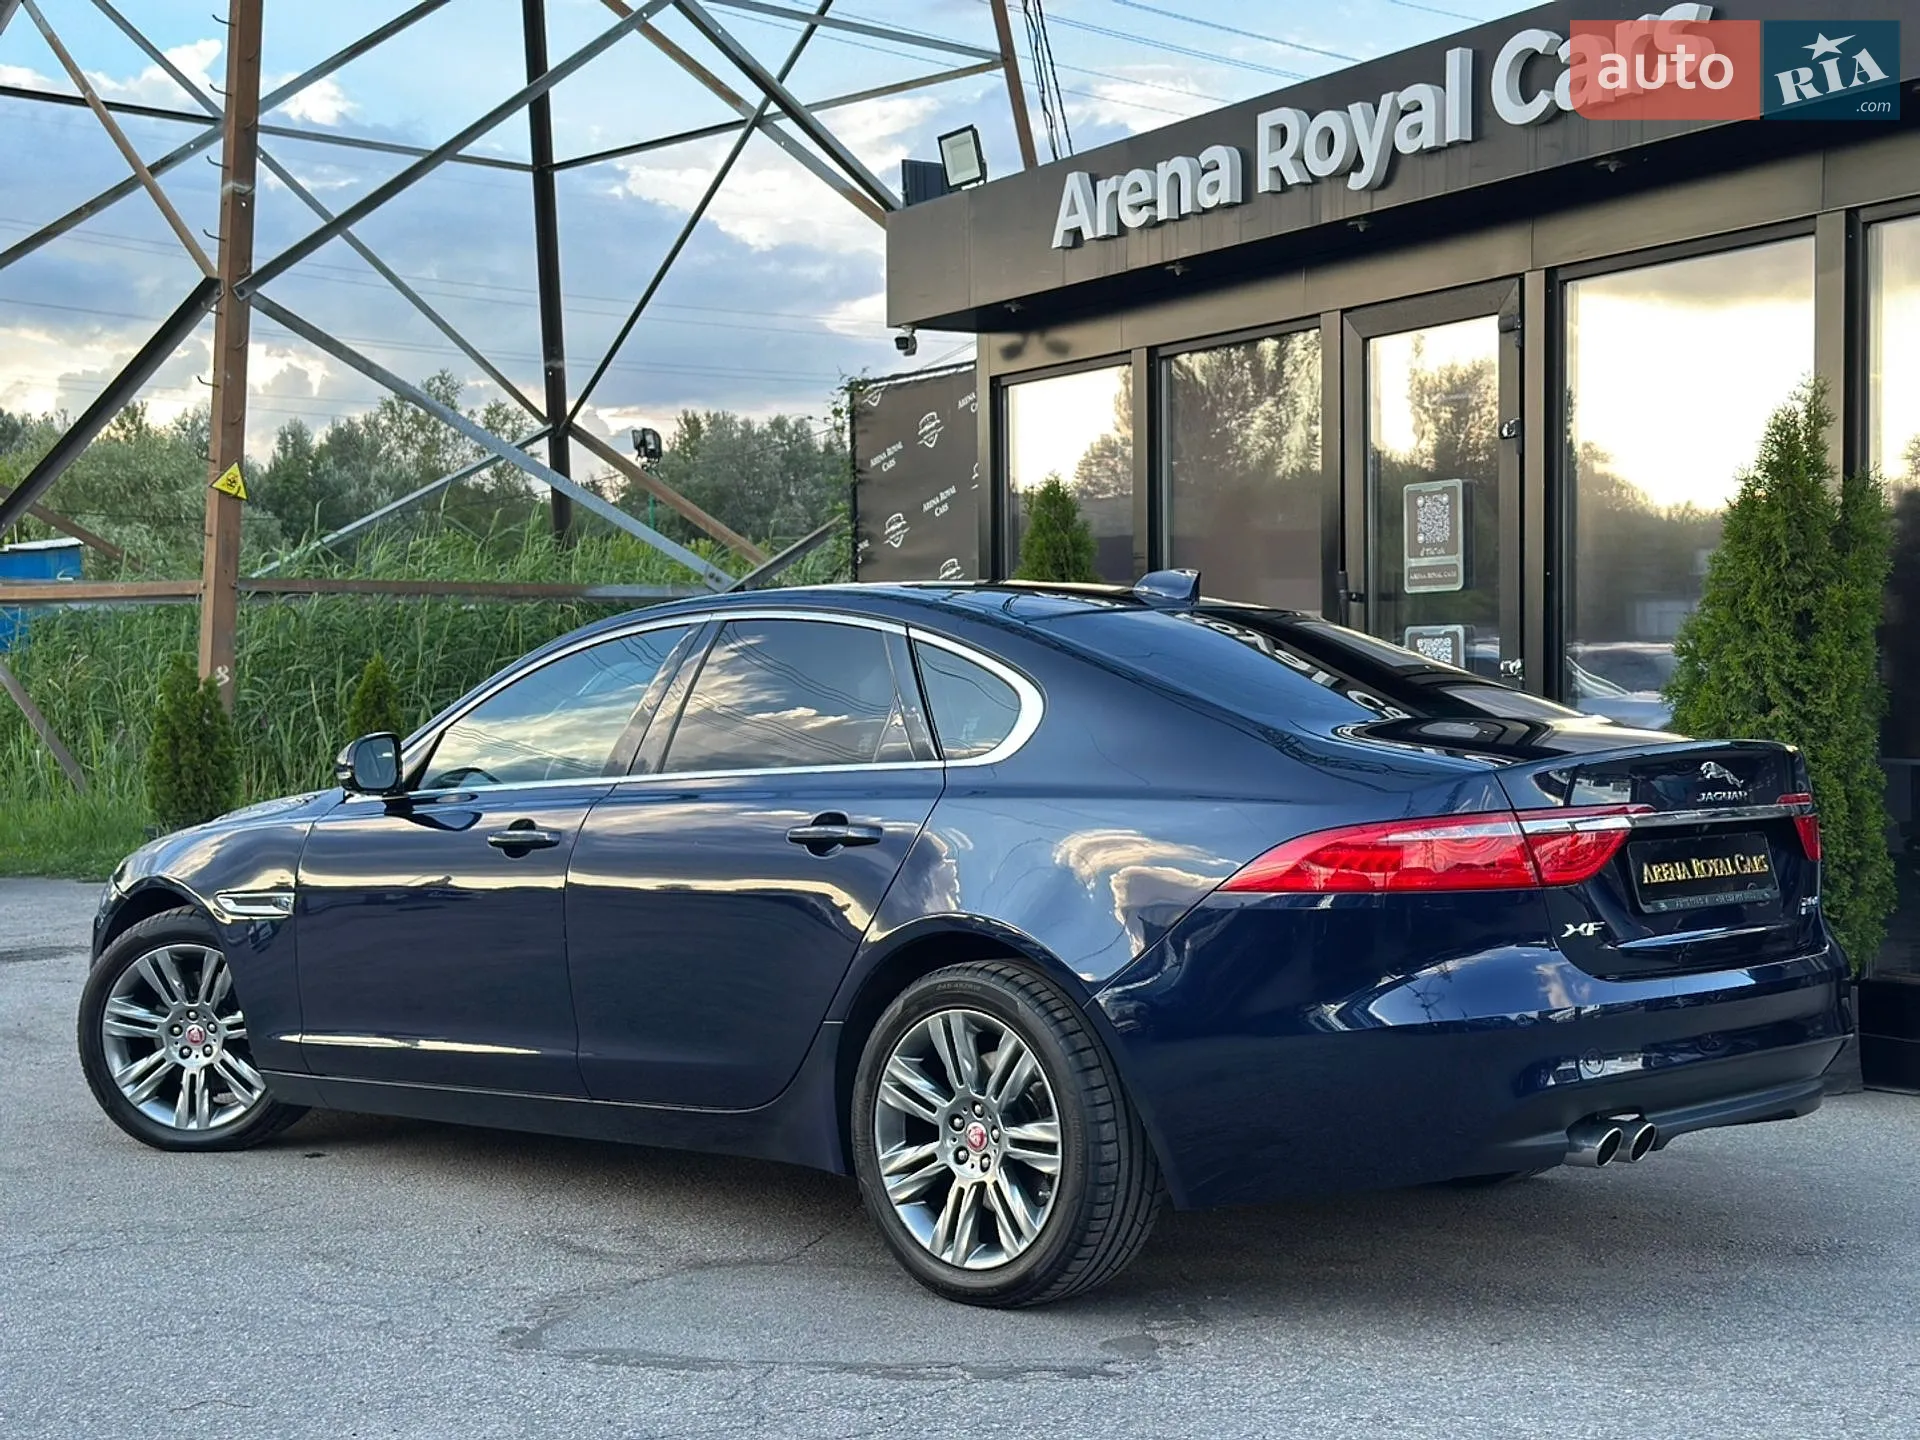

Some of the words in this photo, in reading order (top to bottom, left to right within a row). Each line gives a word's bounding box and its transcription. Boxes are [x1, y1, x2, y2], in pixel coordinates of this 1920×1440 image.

[1052, 145, 1242, 248] Arena
[1257, 46, 1473, 191] Royal
[1491, 2, 1717, 125] Cars
[1696, 790, 1748, 803] JAGUAR
[1642, 861, 1692, 884] ARENA
[1690, 857, 1736, 879] ROYAL
[1734, 853, 1769, 874] CARS
[1561, 921, 1605, 938] XF
